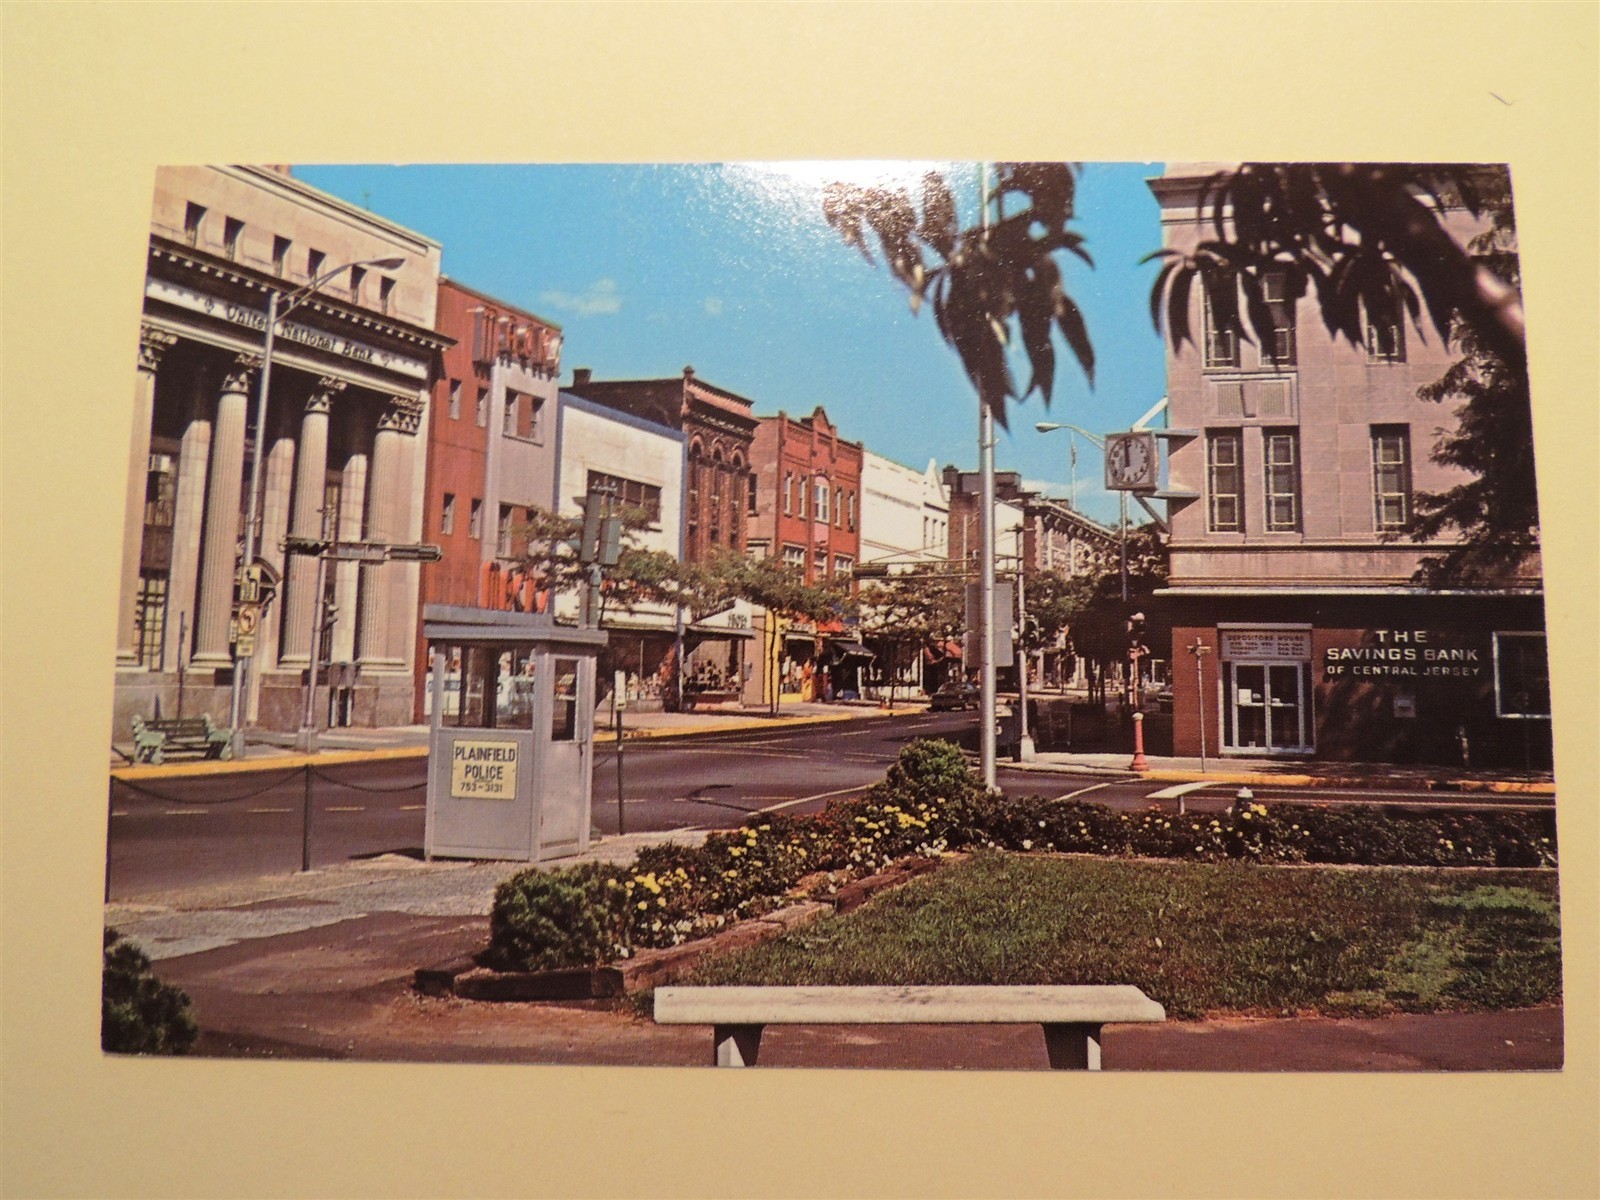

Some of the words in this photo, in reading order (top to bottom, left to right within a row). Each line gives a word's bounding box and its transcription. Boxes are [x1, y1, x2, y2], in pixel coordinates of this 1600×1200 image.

[281, 322, 336, 351] National
[343, 341, 373, 363] Bank
[1376, 630, 1428, 643] THE
[1326, 648, 1417, 661] SAVINGS
[1424, 648, 1479, 661] BANK
[1327, 666, 1345, 675] OF
[1353, 666, 1418, 675] CENTRAL
[1423, 666, 1480, 676] JERSEY
[455, 746, 516, 762] PLAINFIELD
[464, 764, 504, 780] POLICE
[460, 782, 503, 793] 753-3131
